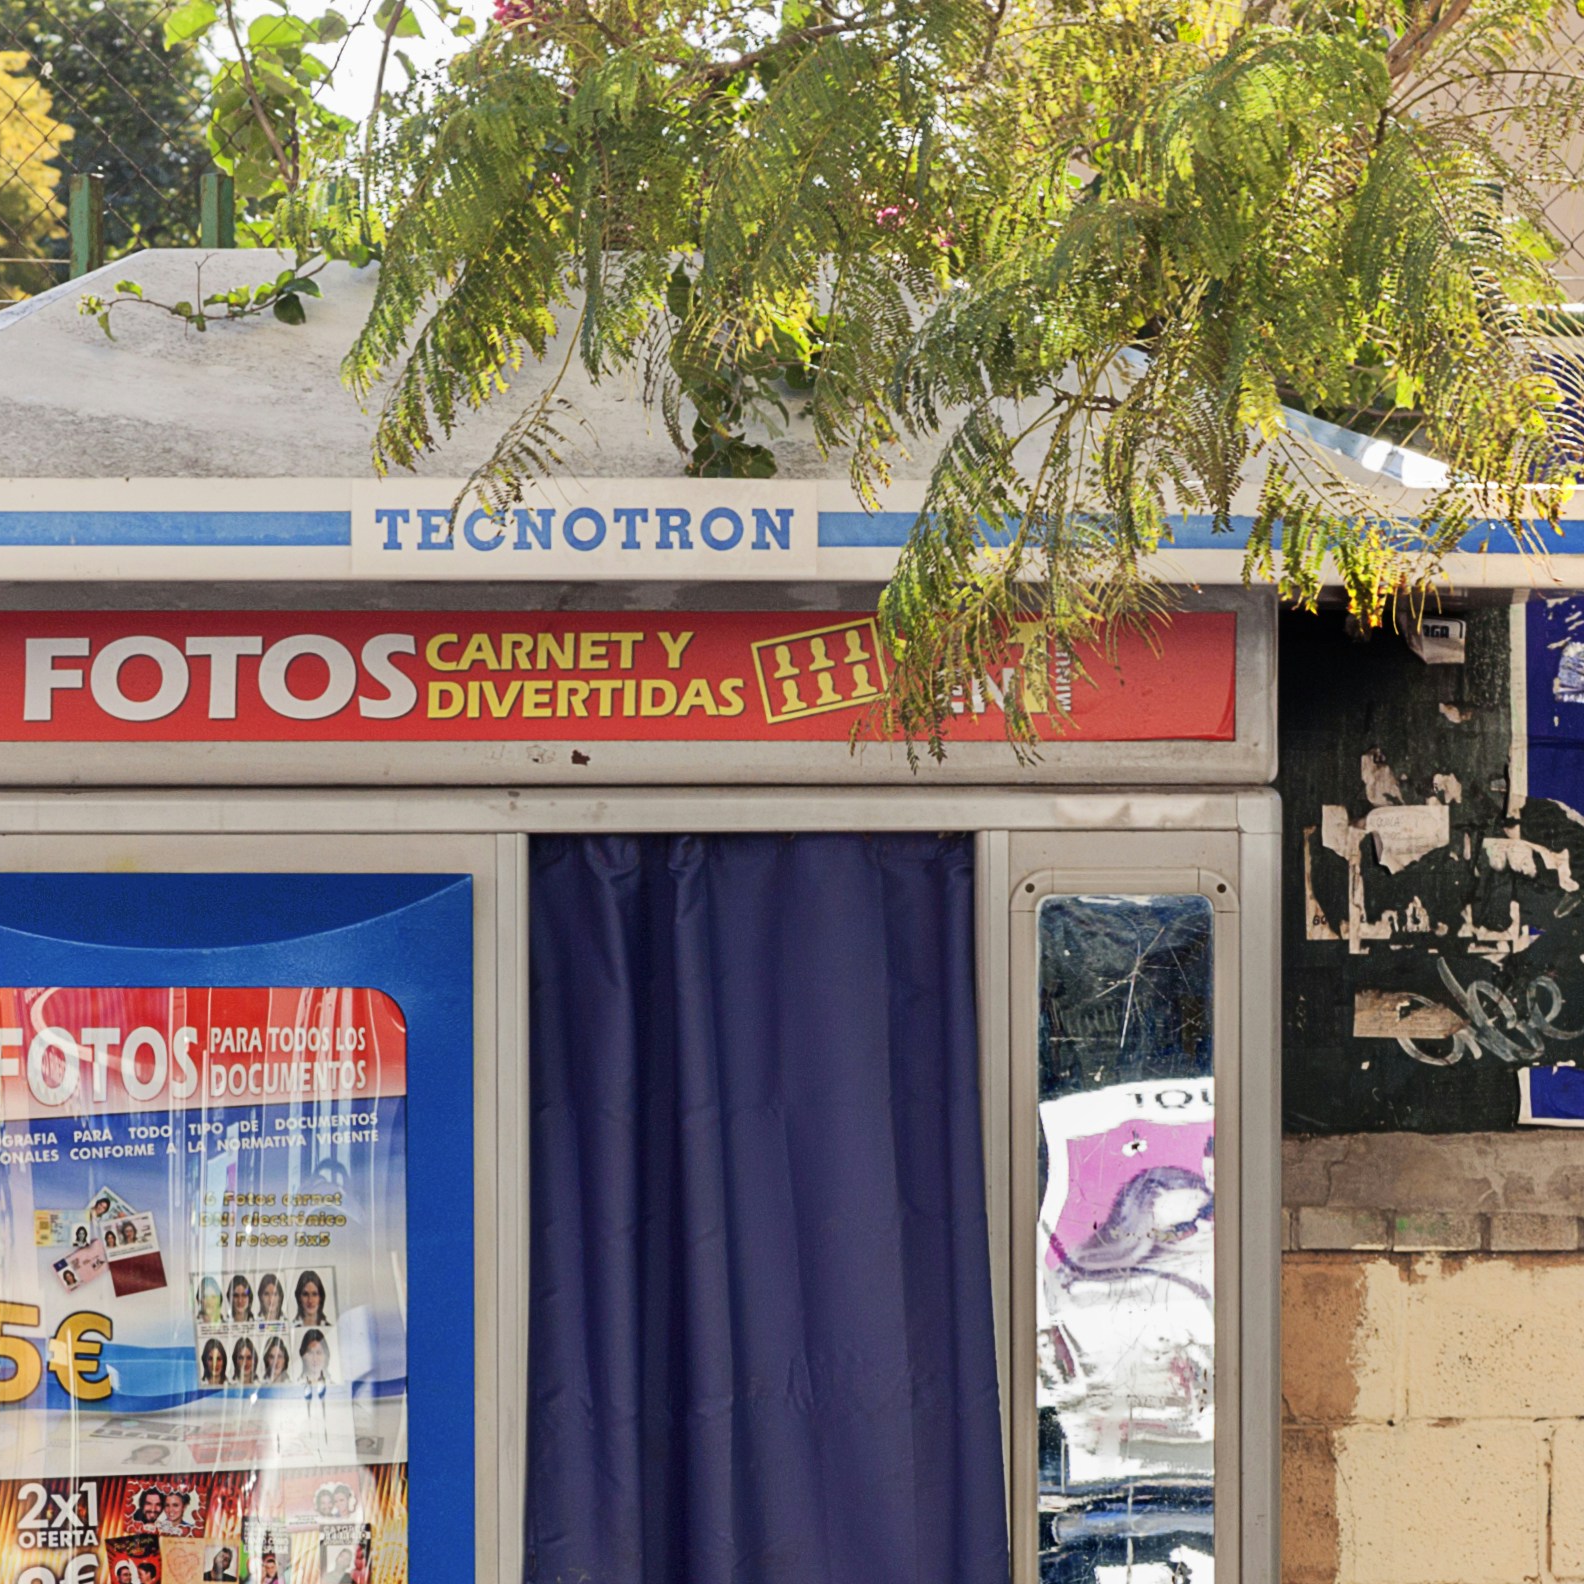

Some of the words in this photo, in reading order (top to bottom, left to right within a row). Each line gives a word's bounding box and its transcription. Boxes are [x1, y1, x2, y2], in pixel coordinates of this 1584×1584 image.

[376, 507, 794, 552] TECNOTRON
[22, 633, 417, 722] FOTOS
[425, 631, 643, 672] CARNET
[656, 631, 694, 669] Y
[426, 679, 745, 719] DIVERTIDAS
[209, 1027, 263, 1055] PARA
[267, 1026, 330, 1054] TODOS
[335, 1026, 366, 1052] LOS
[210, 1060, 367, 1097] DOCUMENTOS
[74, 1128, 113, 1143] PARA
[129, 1126, 172, 1140] TODO
[188, 1122, 223, 1135] TIPO
[240, 1120, 259, 1133] DE
[275, 1113, 379, 1131] DOCUMENTOS
[70, 1144, 155, 1160] CONFORME
[166, 1142, 177, 1154] A
[188, 1142, 207, 1153] LA
[217, 1134, 307, 1151] NORMATIVA
[317, 1130, 379, 1145] VIGENTE
[223, 1190, 276, 1206] Fotos
[282, 1192, 342, 1206] carnet
[217, 1233, 228, 1247] 2
[235, 1233, 288, 1247] Fotos
[295, 1232, 331, 1247] 5x5
[17, 1482, 99, 1529] 2x1
[18, 1529, 99, 1549] OFERTA
